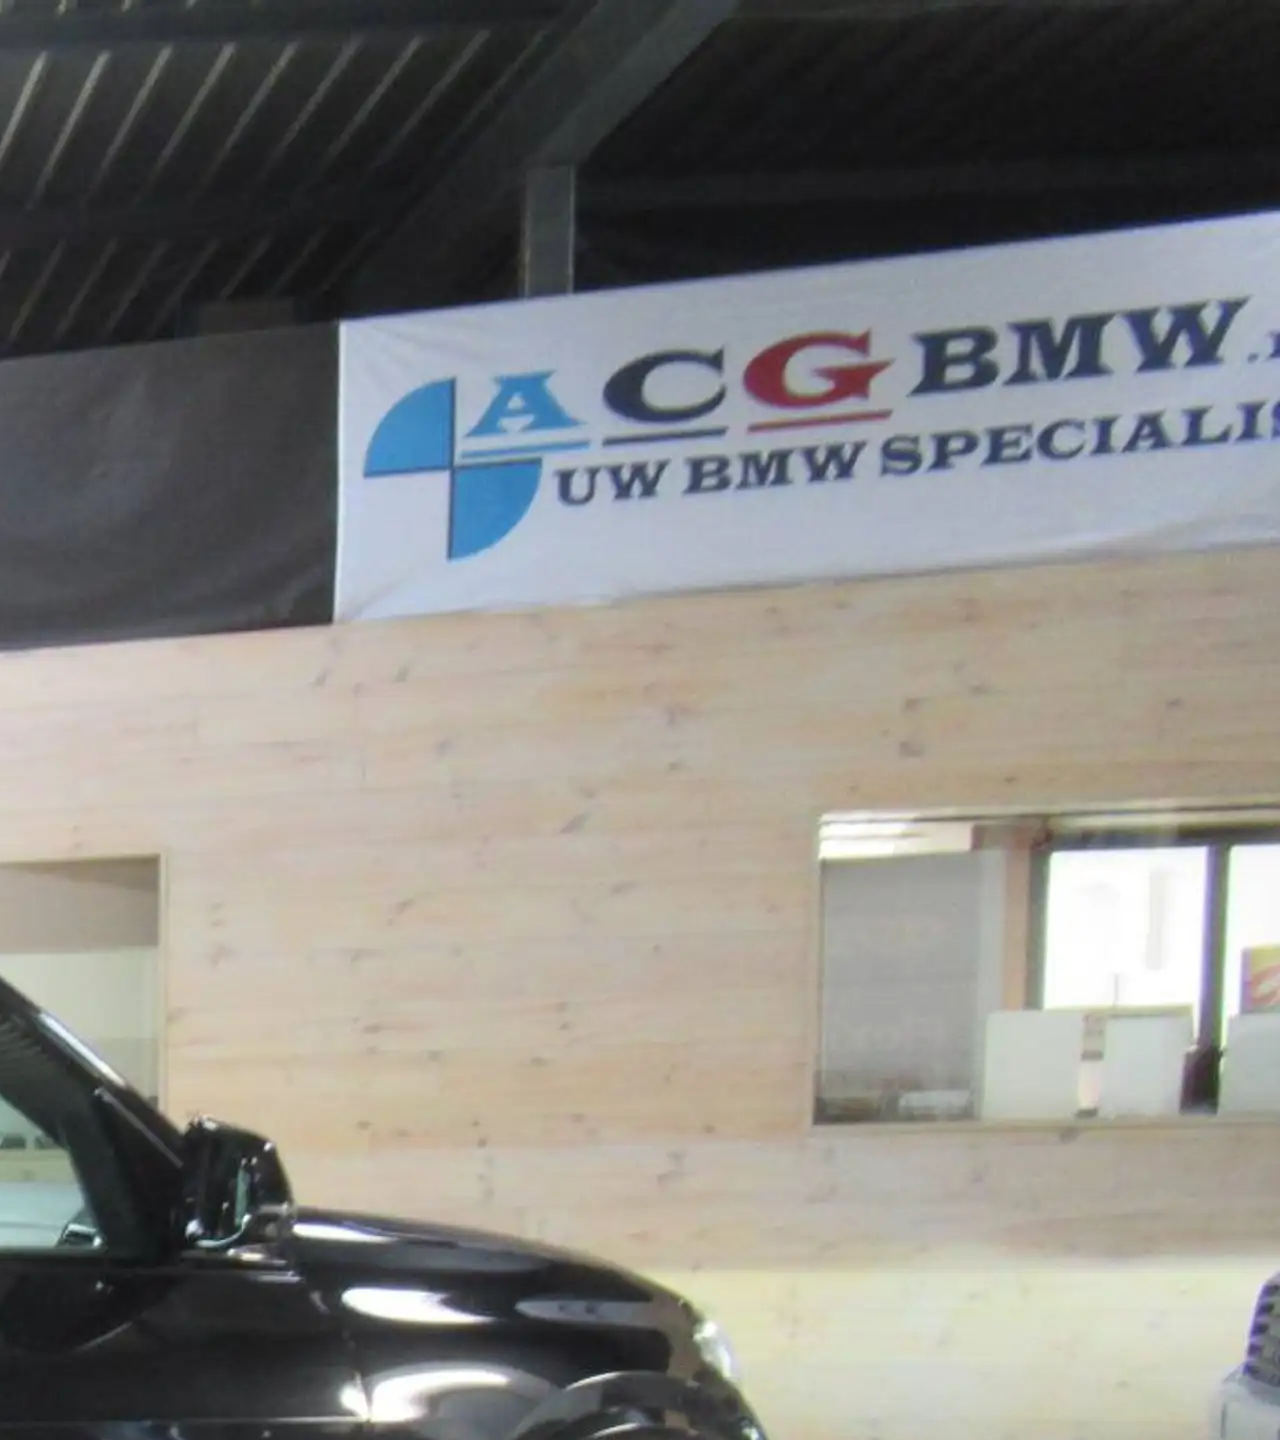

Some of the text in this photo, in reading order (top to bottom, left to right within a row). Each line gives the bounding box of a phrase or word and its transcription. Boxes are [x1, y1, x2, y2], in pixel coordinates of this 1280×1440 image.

[906, 295, 1280, 397] BMW.
[554, 398, 1280, 506] UW BMW SPECIALI
